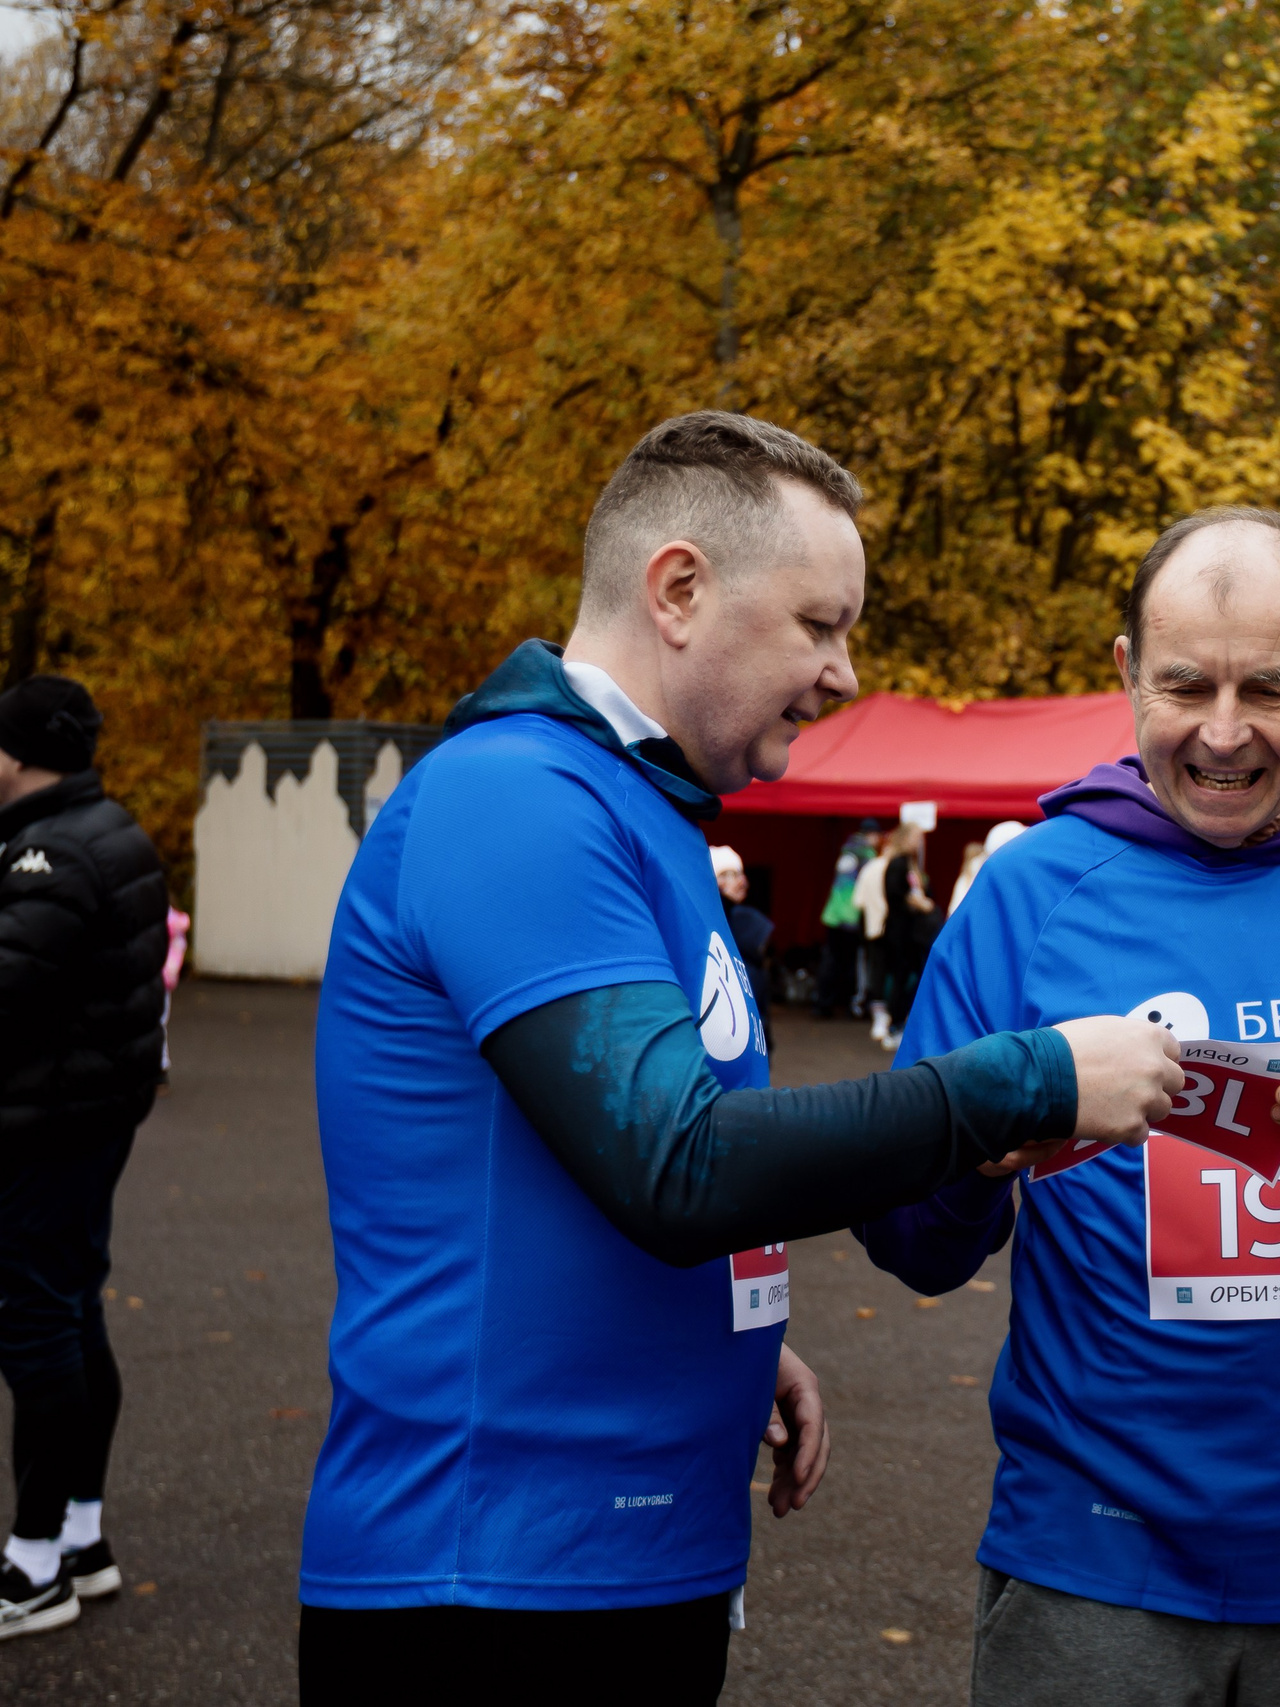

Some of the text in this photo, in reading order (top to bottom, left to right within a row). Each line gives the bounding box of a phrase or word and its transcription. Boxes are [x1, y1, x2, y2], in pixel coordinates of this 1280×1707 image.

[1185, 1048, 1249, 1066] ОРБИ
[1210, 1285, 1269, 1303] ОРБИ
[627, 1493, 674, 1508] LUCKYGRASS
